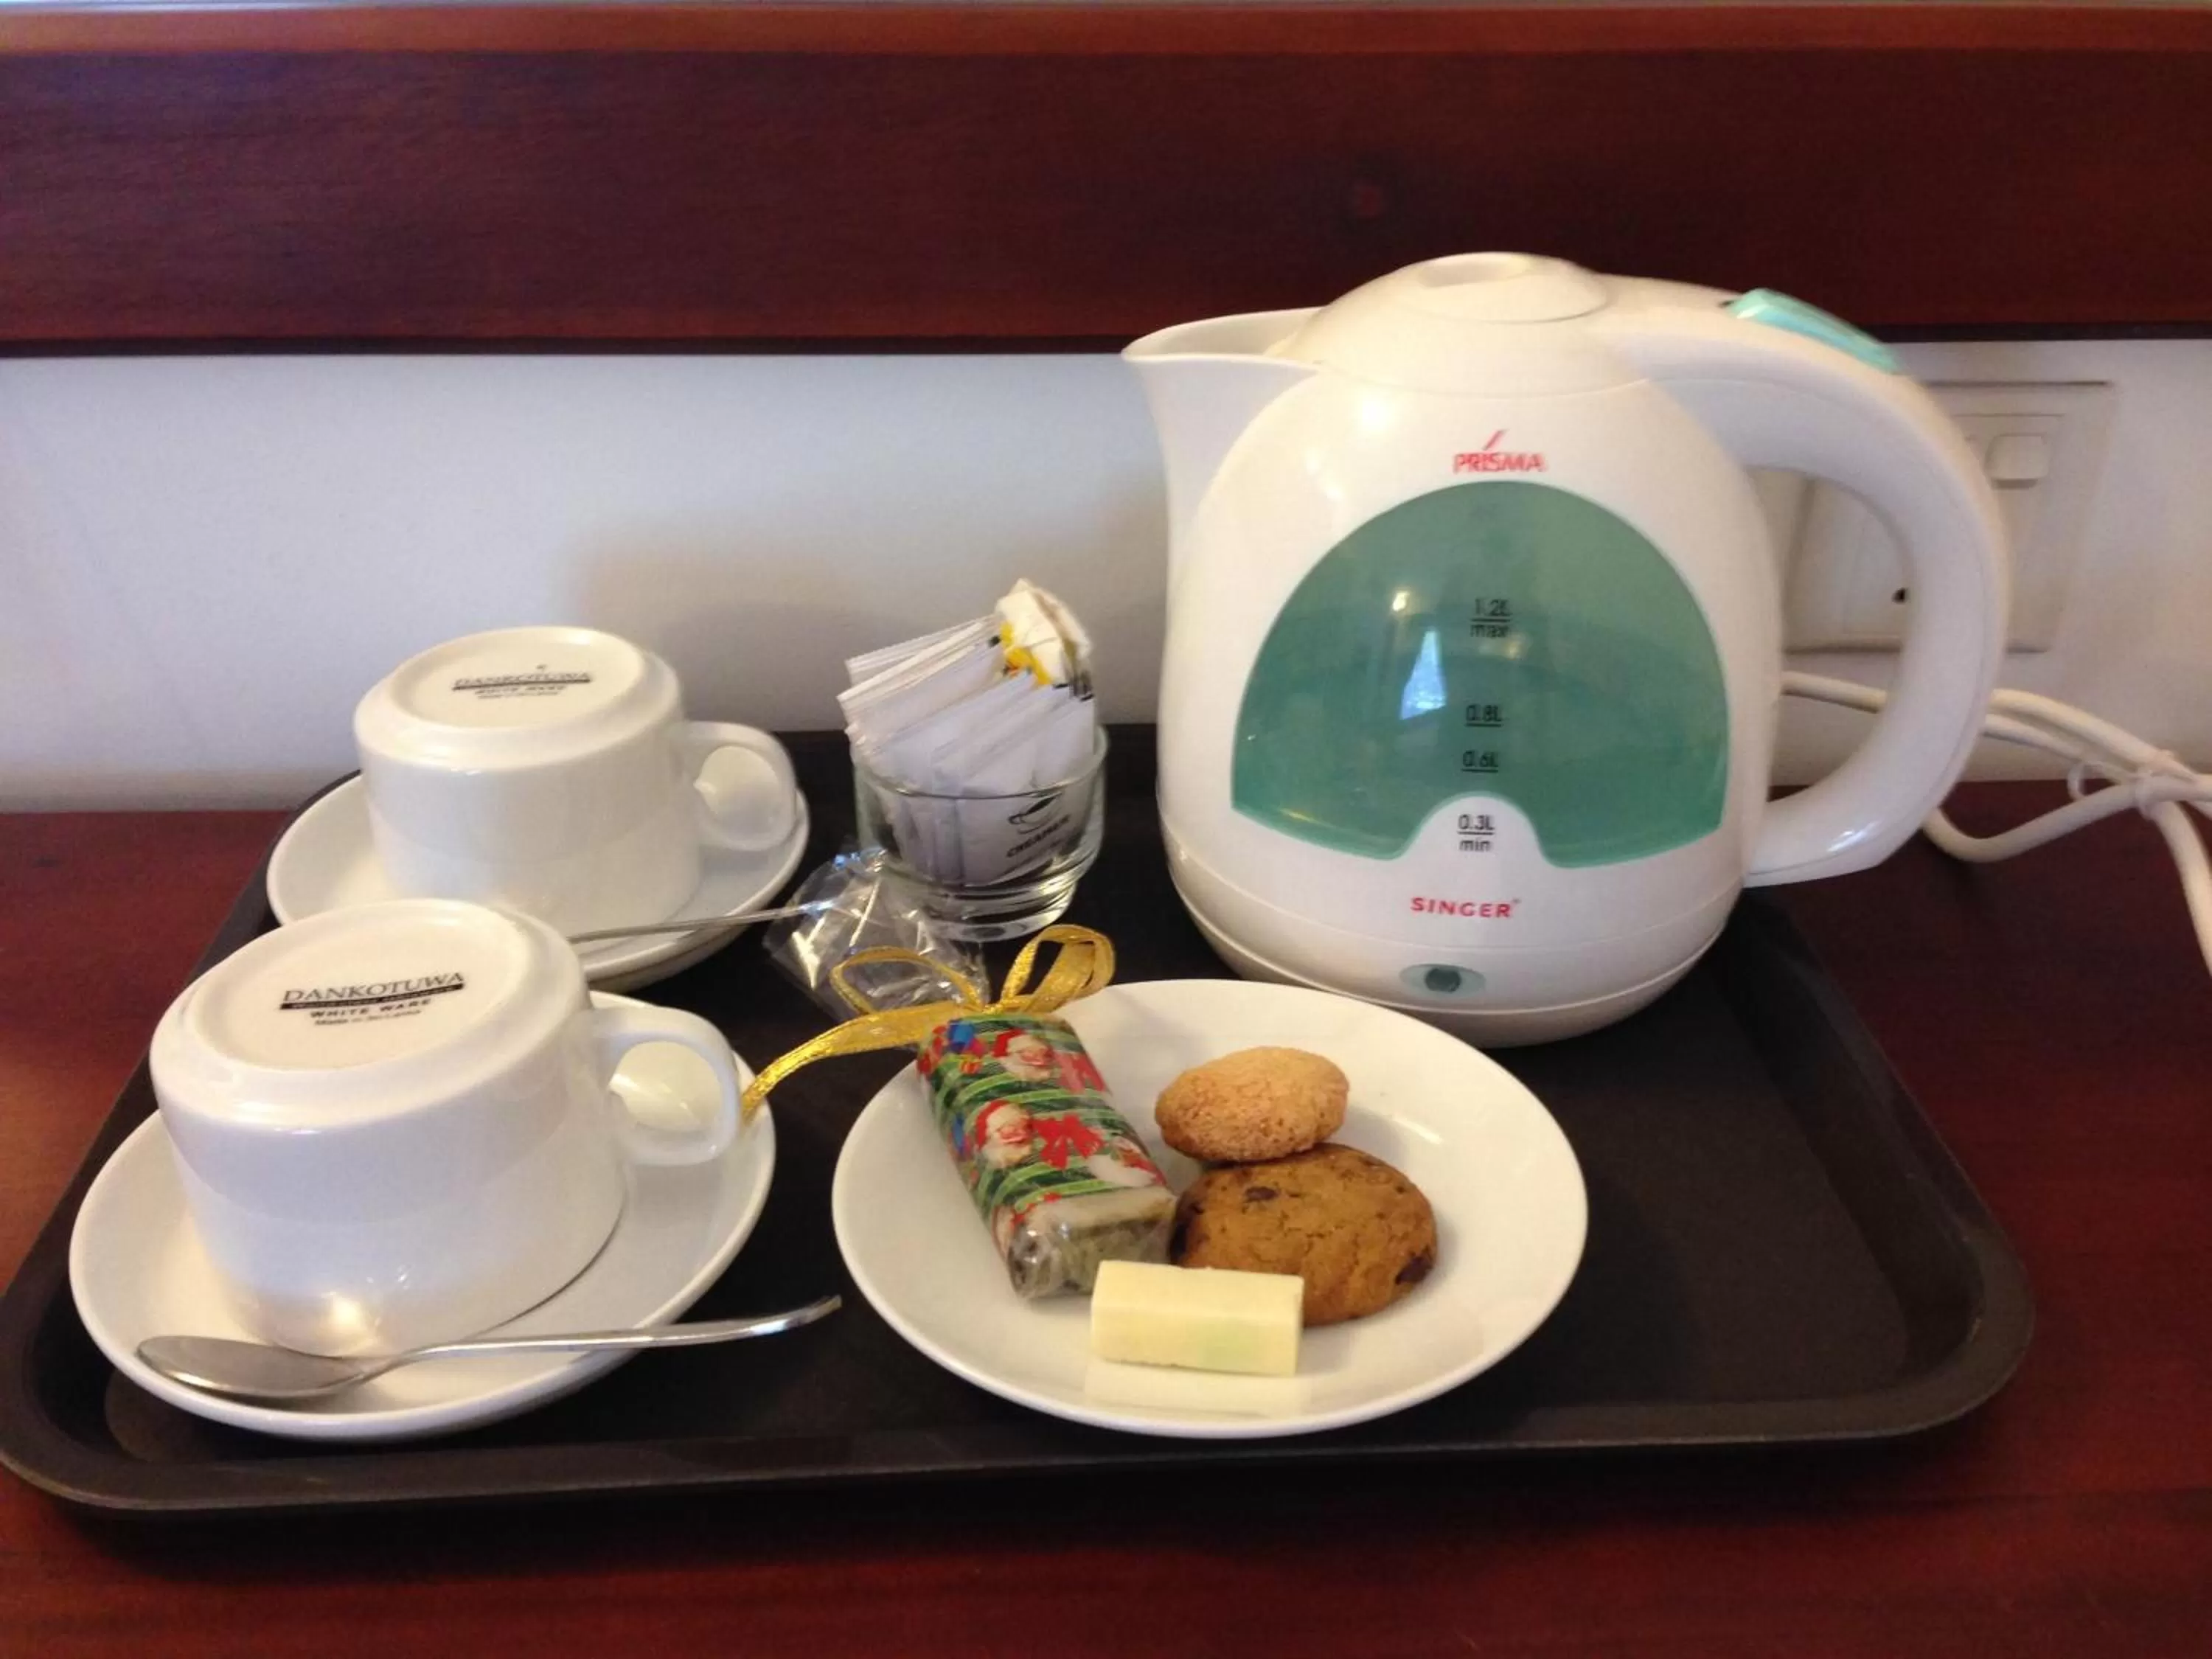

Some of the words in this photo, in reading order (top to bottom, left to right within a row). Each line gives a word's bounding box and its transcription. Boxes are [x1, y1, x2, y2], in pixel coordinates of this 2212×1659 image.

[1470, 625, 1509, 638] max
[1466, 704, 1502, 722] 0.8L
[1462, 750, 1499, 768] 0.6L
[1458, 814, 1495, 830] 0.3L
[1459, 839, 1492, 852] min
[1411, 896, 1512, 918] SINGER
[283, 973, 464, 1001] DANKOTUWA
[310, 1007, 369, 1018] WHITE
